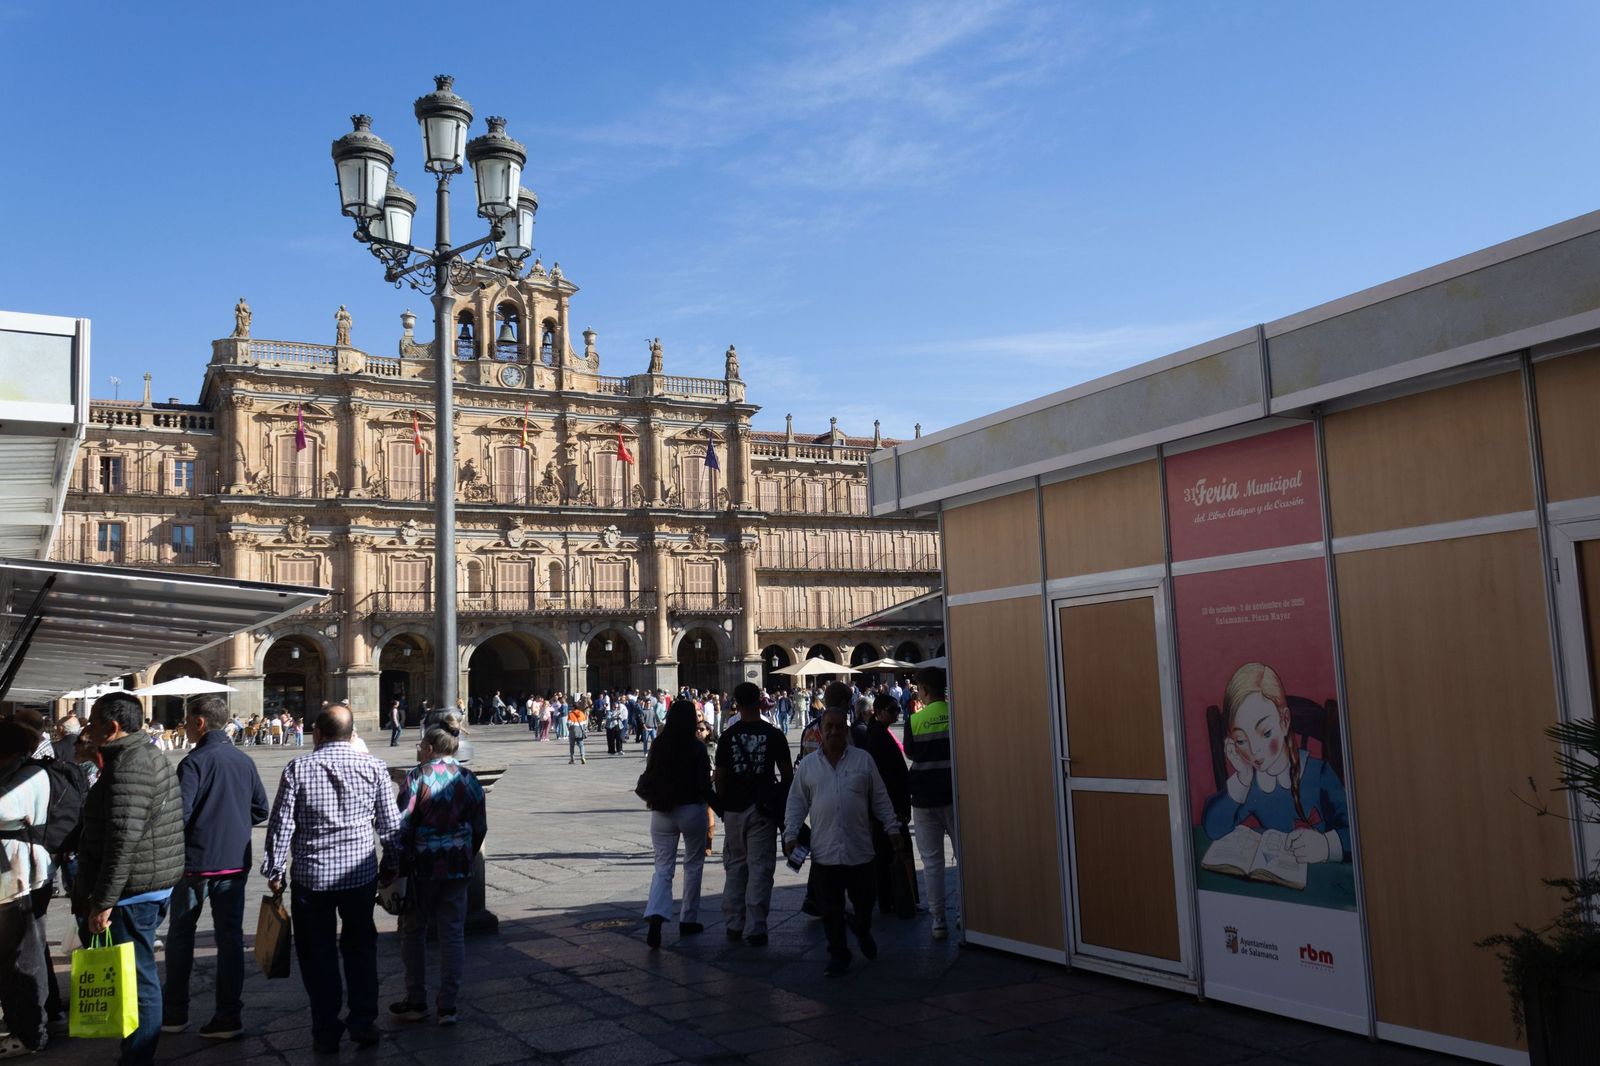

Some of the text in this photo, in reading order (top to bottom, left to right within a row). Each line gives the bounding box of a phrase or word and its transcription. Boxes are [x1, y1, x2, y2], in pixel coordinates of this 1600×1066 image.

[1194, 478, 1239, 507] Feria
[1243, 469, 1304, 497] Municipal
[1194, 513, 1206, 523] del
[1207, 511, 1227, 521] Libro
[1227, 507, 1256, 518] Antiguo
[1264, 502, 1273, 511] de
[1274, 496, 1305, 509] Ocasión
[1240, 937, 1278, 951] Ayuntamiento
[1249, 948, 1279, 961] Salamanca
[1299, 943, 1334, 965] rbm
[80, 970, 95, 984] de
[79, 985, 115, 999] buena
[79, 999, 108, 1013] tinta
